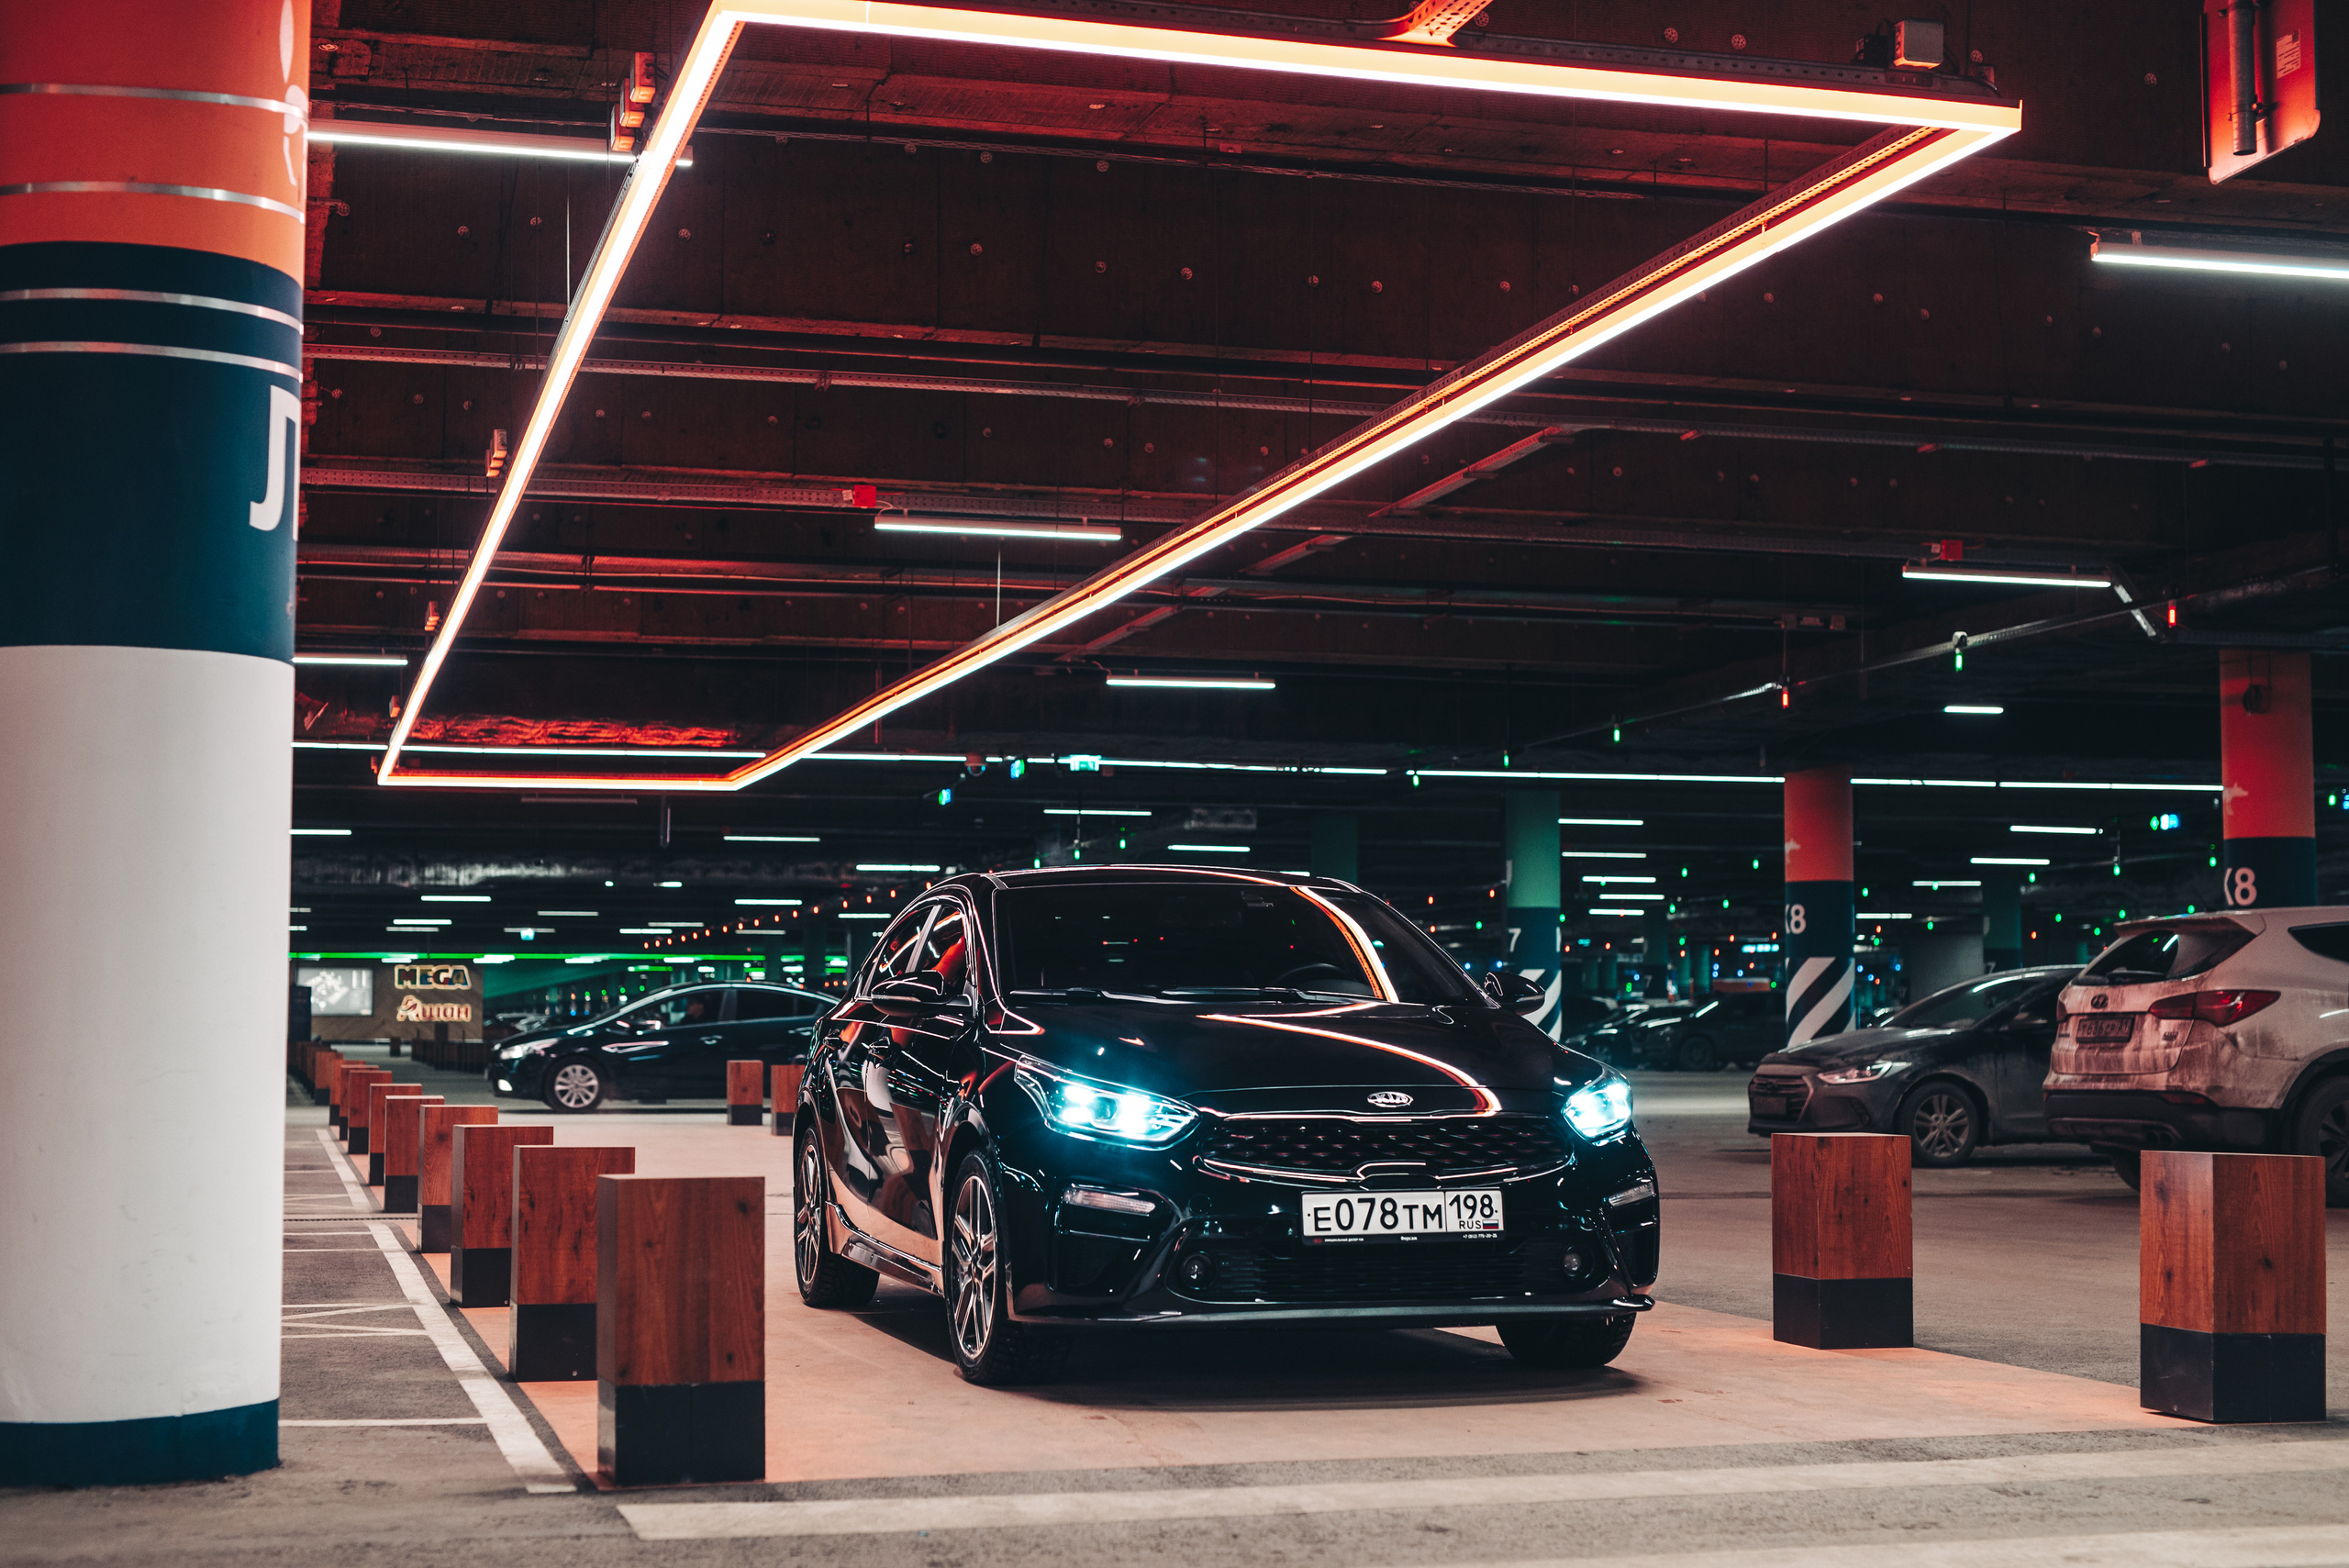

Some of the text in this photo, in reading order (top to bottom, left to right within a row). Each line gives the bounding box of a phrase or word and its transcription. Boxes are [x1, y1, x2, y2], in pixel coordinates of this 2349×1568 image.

[1508, 928, 1521, 952] 7
[395, 964, 472, 990] MEGA
[1367, 1091, 1414, 1107] KIA
[1448, 1194, 1494, 1219] 198
[1458, 1219, 1482, 1229] RUS
